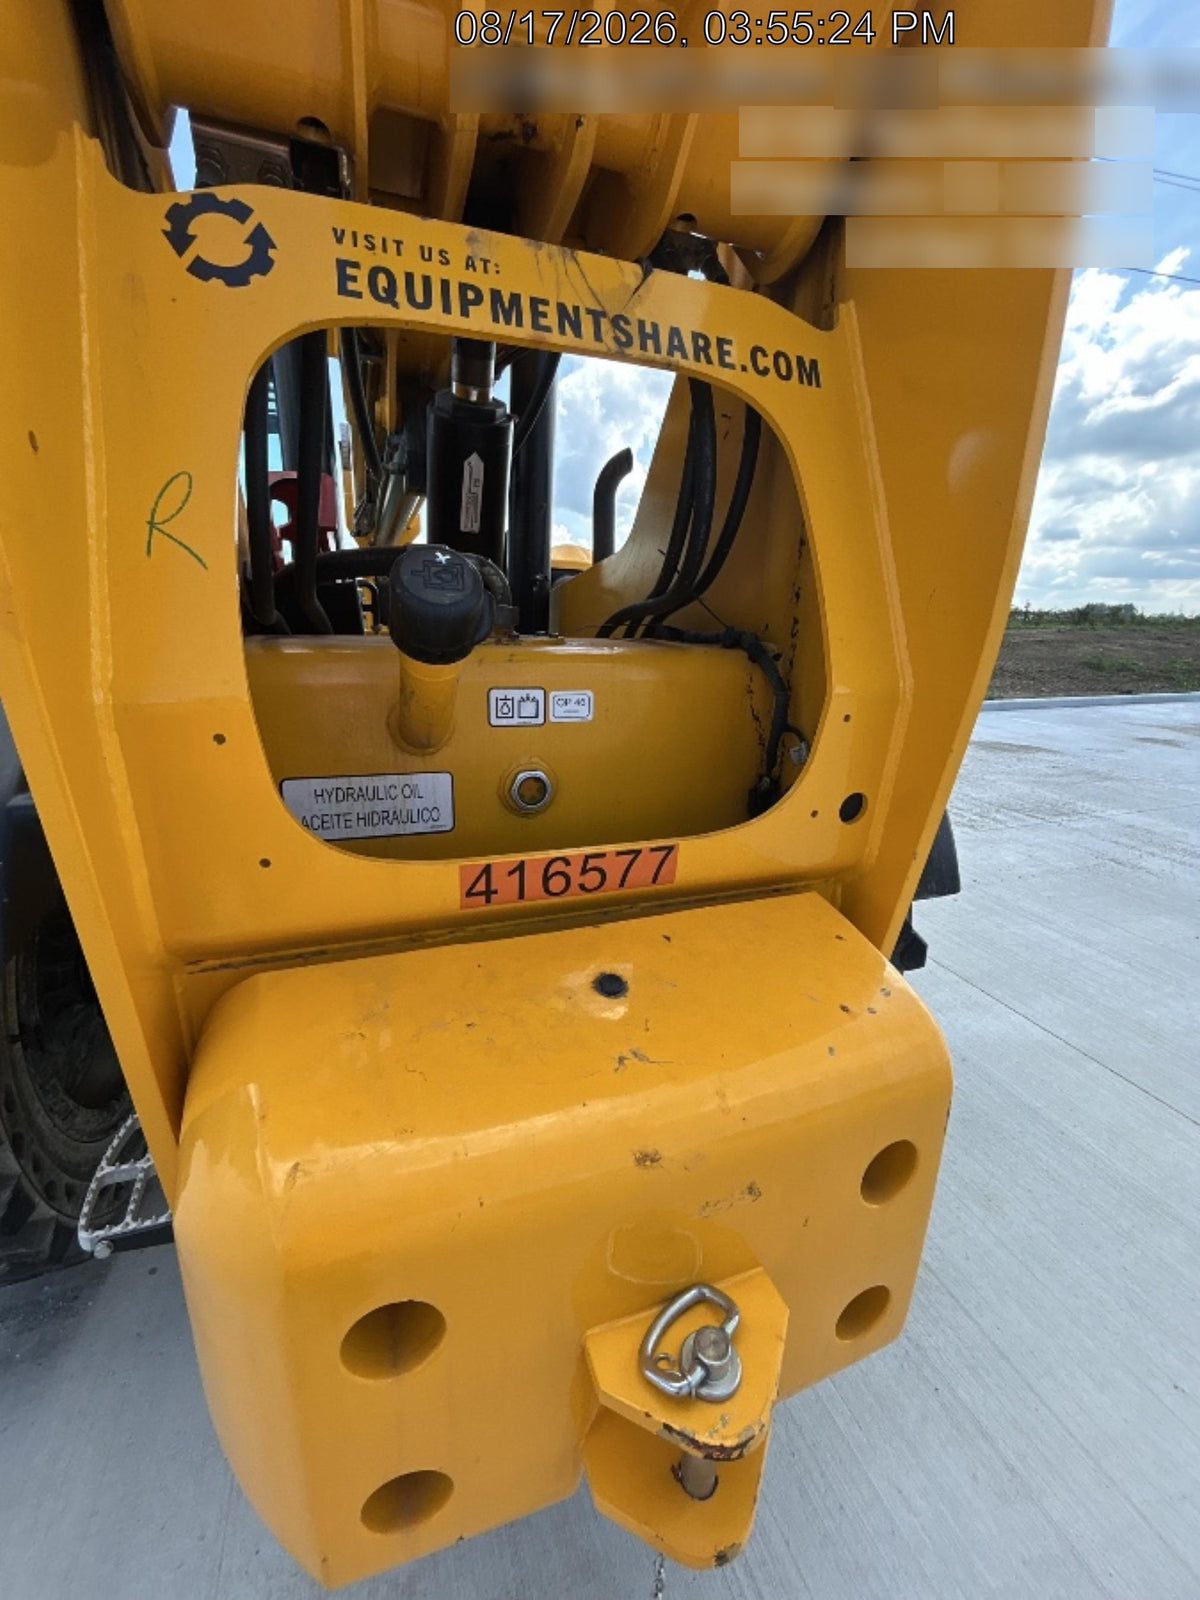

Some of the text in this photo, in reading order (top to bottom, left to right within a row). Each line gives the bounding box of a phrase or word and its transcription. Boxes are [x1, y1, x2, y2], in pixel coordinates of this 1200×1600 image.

[332, 226, 501, 275] VISIT US AT:
[335, 257, 822, 389] EQUIPMENTSHARE.COM
[145, 470, 209, 570] R
[301, 806, 441, 832] ACEITE HIDRAULICO
[313, 783, 424, 805] HYDRAULIC OIL
[464, 844, 677, 905] 416577
